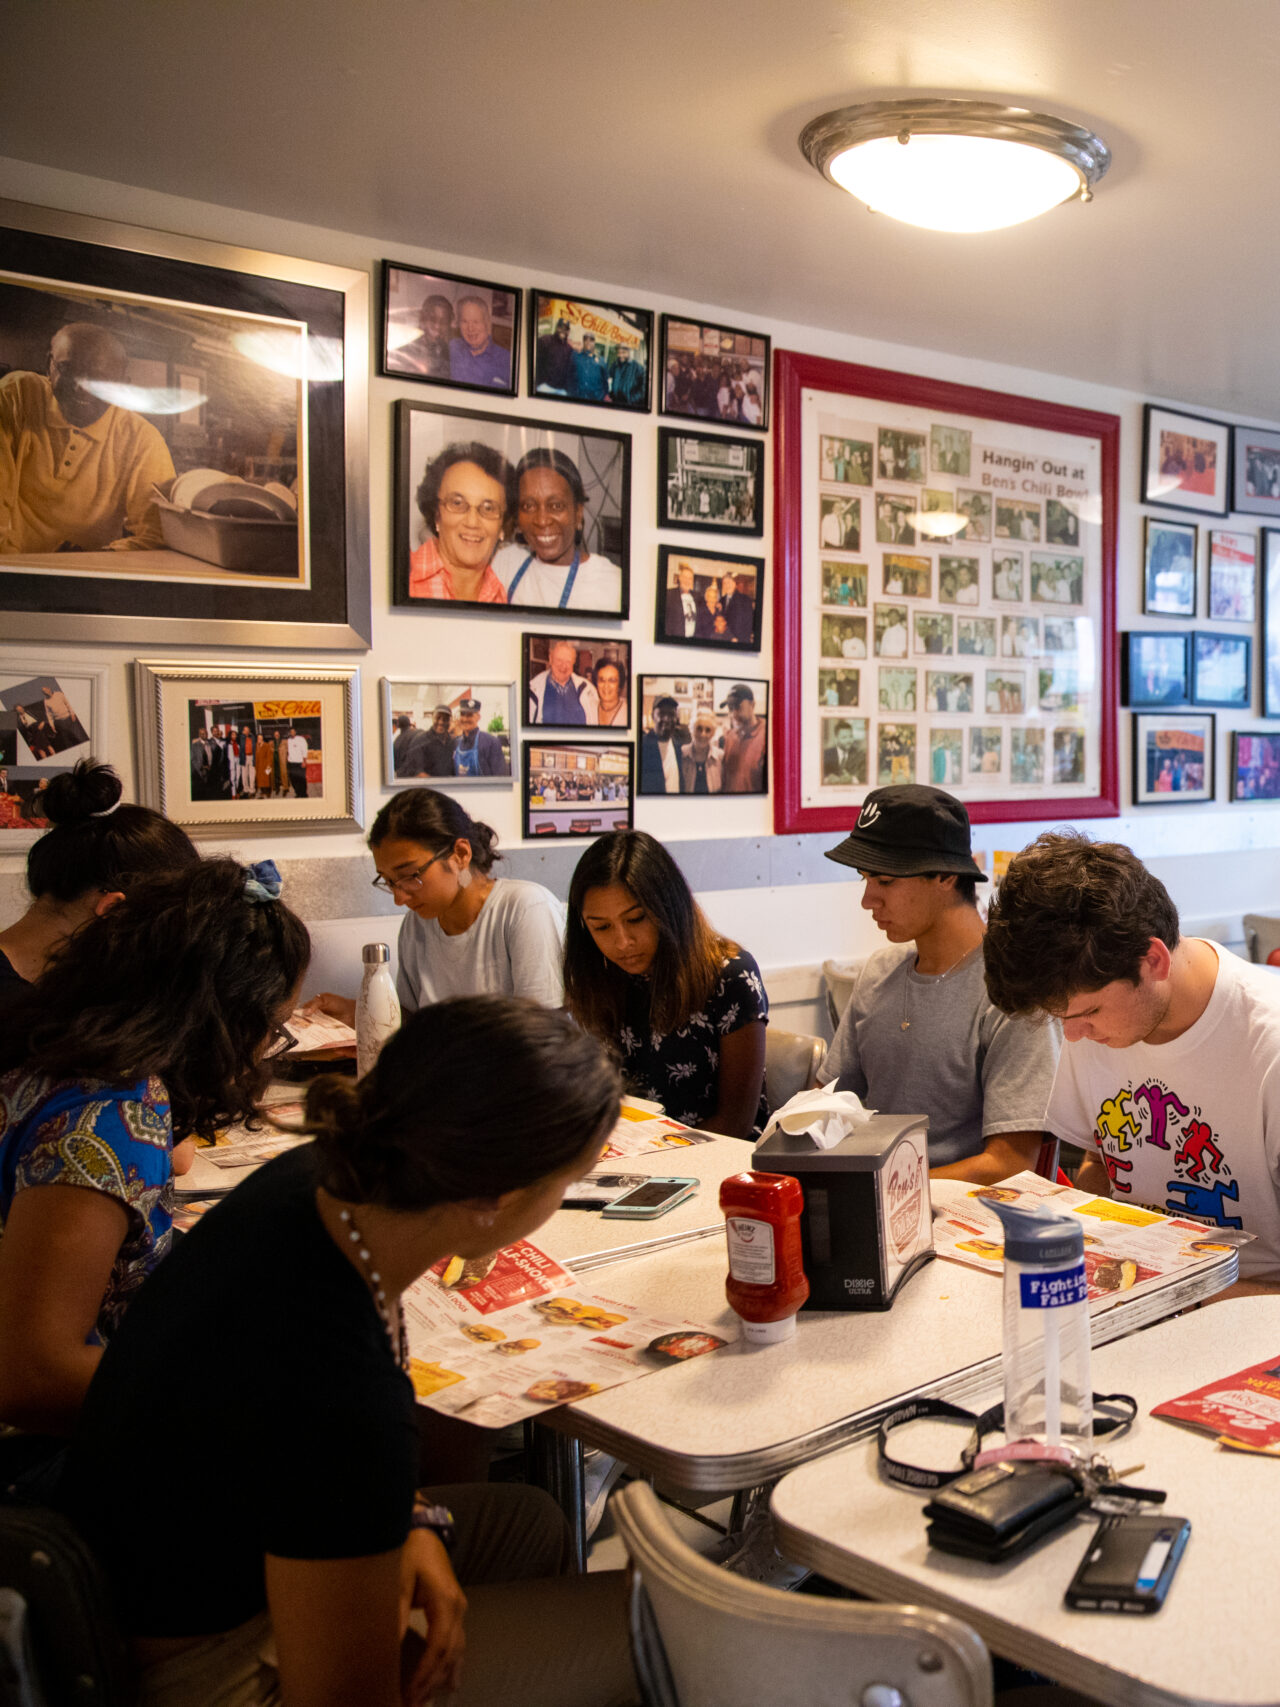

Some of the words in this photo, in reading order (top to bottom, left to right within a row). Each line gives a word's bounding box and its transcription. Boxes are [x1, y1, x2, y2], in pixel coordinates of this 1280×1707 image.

[982, 450, 1037, 473] Hangin'
[1041, 461, 1067, 477] Out
[1071, 468, 1084, 480] at
[981, 473, 1016, 491] Ben's
[1021, 479, 1052, 496] Chili
[499, 1248, 552, 1291] LF-SMOKE
[520, 1247, 552, 1269] CHILI
[1030, 1271, 1088, 1295] Fightin
[1041, 1291, 1074, 1306] Fair
